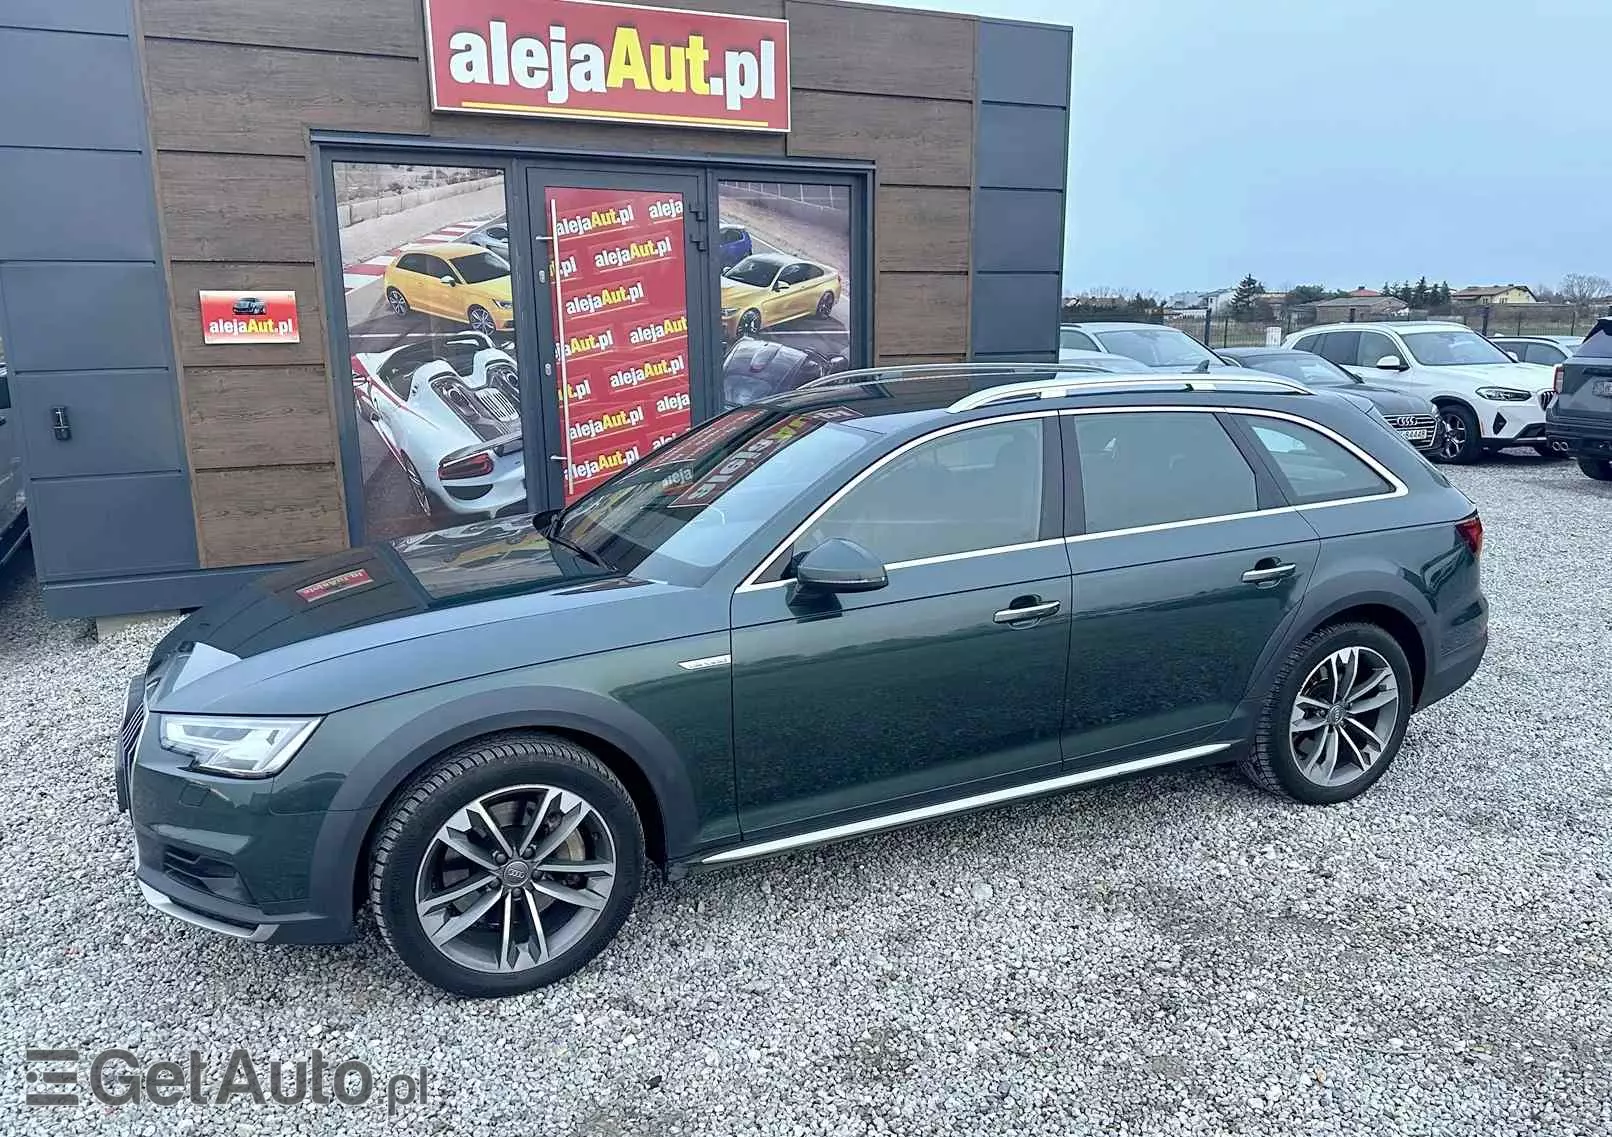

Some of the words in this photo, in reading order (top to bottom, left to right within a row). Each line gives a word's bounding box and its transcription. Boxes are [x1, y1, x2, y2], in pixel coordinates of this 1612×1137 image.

[449, 20, 775, 110] alejaAut.pl
[556, 204, 634, 236] alejaAut.pl
[594, 237, 672, 268] alejaAut.pl
[565, 282, 644, 314] alejaAut.pl
[209, 319, 293, 336] alejaAut.pl
[609, 355, 685, 388] alejaAut.pl
[569, 406, 644, 440] alejaAut.pl
